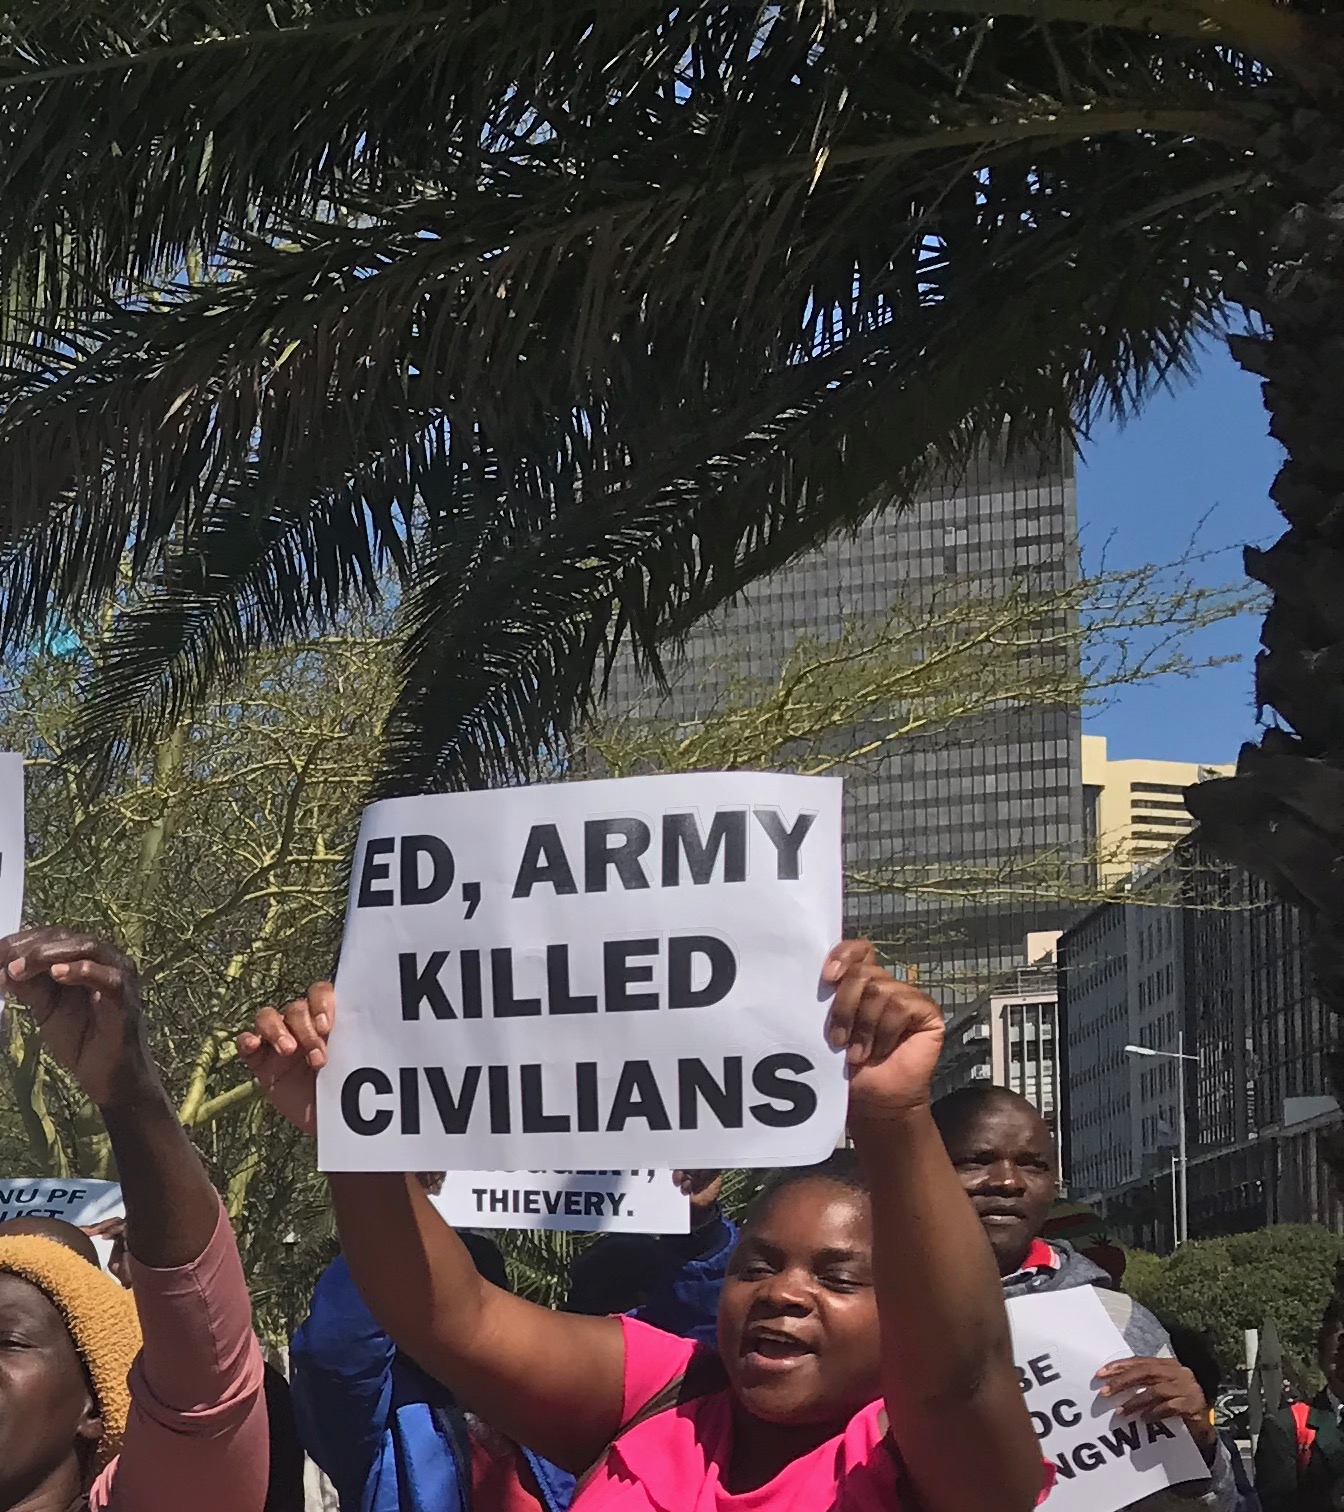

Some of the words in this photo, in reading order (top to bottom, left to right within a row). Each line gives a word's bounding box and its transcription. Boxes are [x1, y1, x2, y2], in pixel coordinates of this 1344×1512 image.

[357, 834, 480, 920] ED,
[512, 809, 818, 899] ARMY
[398, 934, 738, 1021] KILLED
[340, 1052, 818, 1136] CIVILIANS
[47, 1189, 87, 1204] PF
[472, 1188, 634, 1217] THIEVERY.
